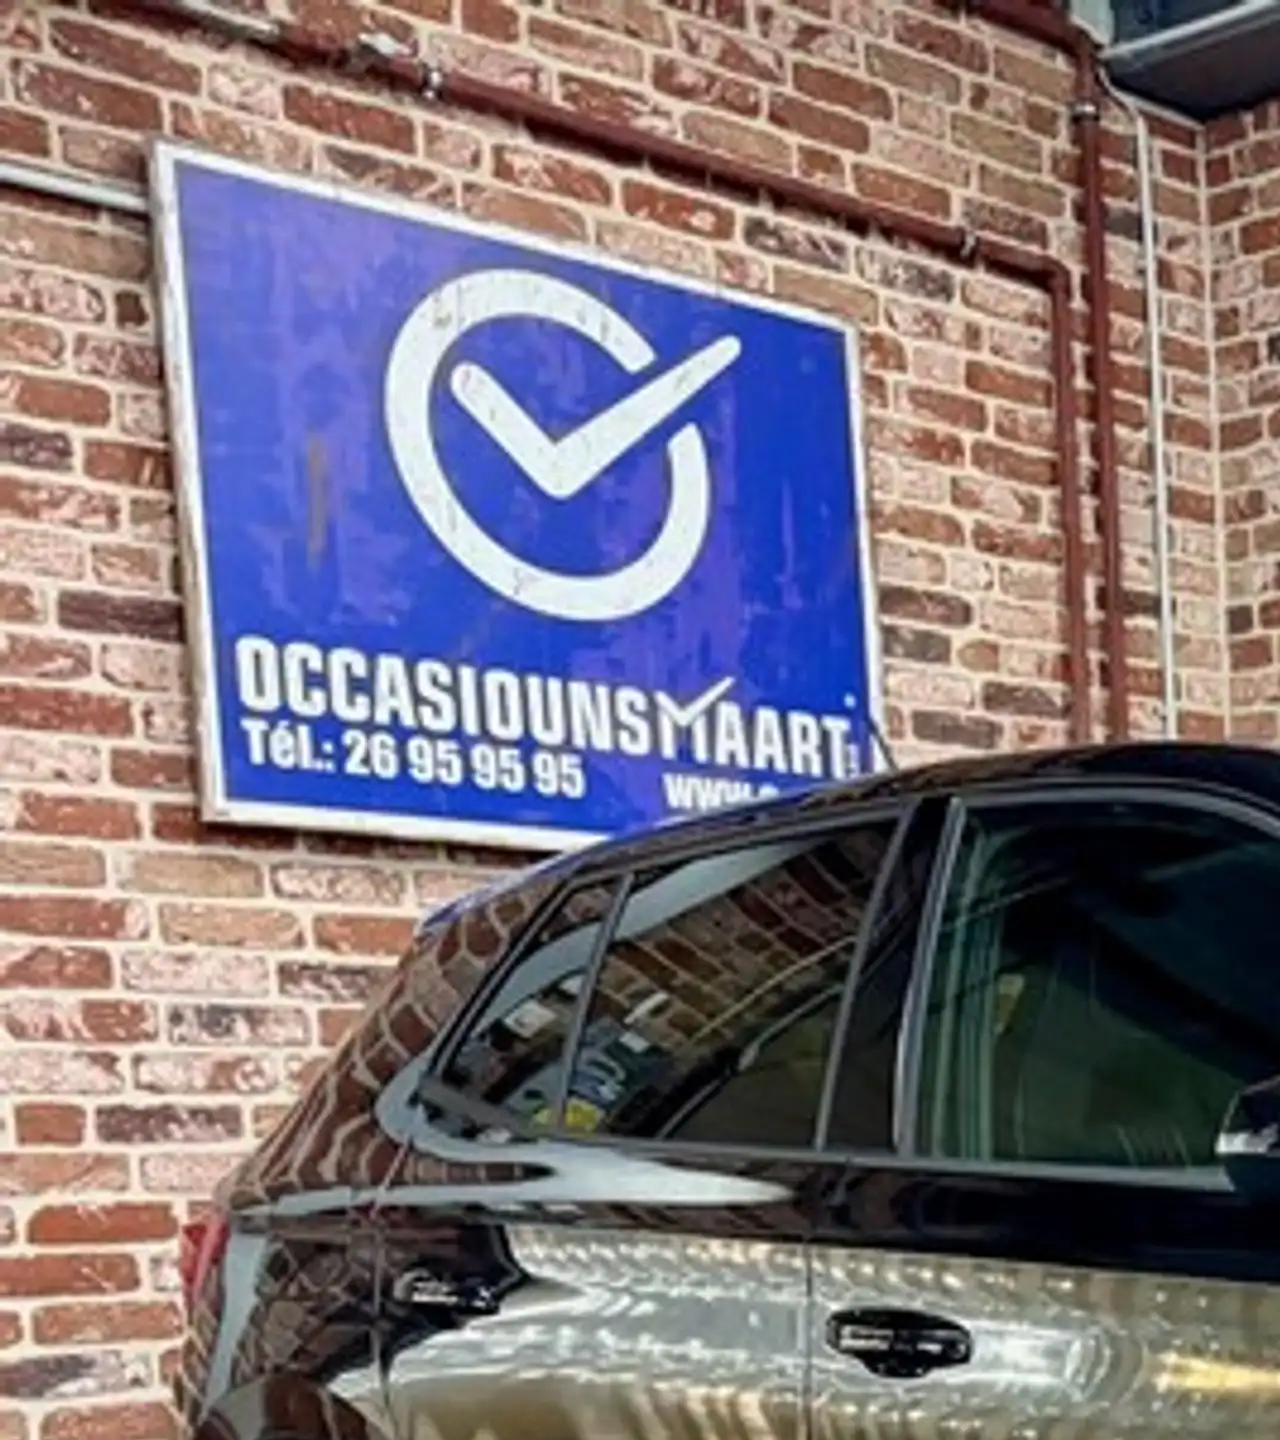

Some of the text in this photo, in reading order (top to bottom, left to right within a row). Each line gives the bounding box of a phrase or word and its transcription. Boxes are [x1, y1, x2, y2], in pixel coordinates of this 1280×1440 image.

[234, 633, 852, 781] OCCASIOUNSMAART
[341, 729, 398, 780] 26
[407, 735, 463, 786] 95
[471, 743, 525, 793] 95
[532, 749, 586, 800] 95
